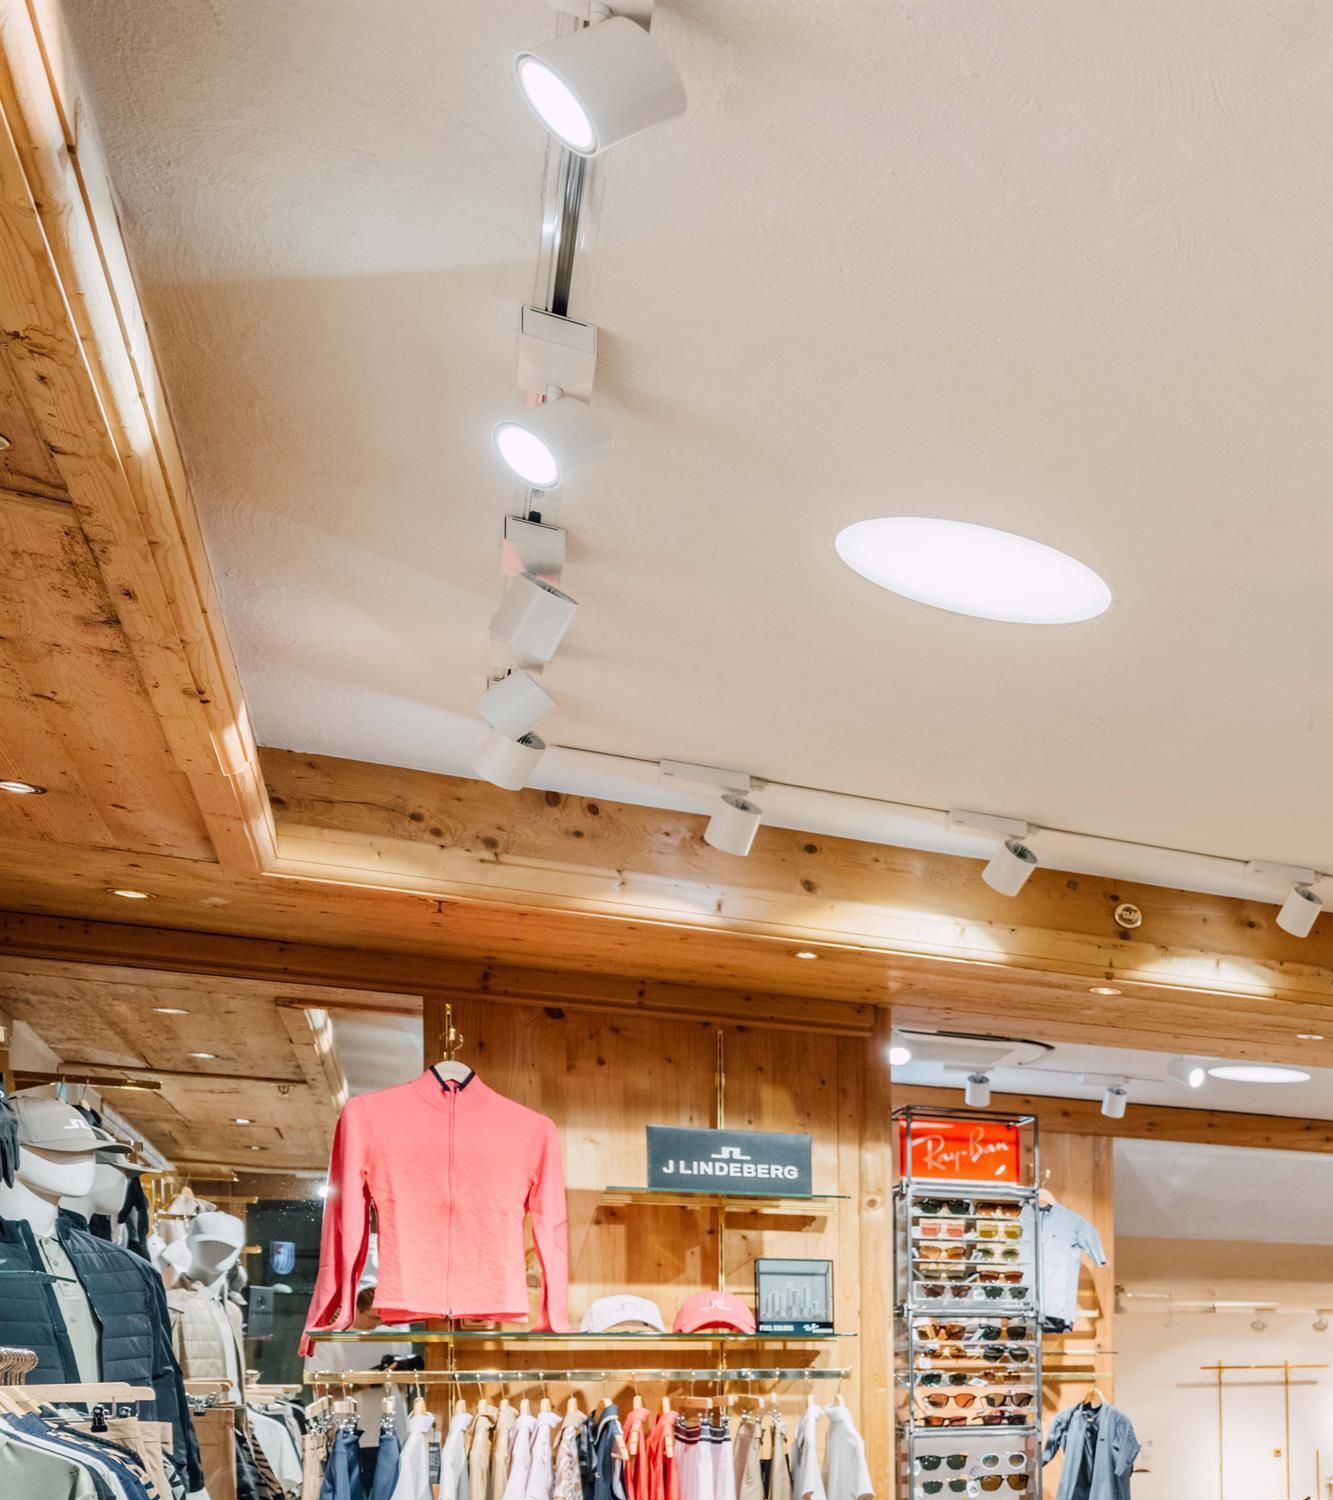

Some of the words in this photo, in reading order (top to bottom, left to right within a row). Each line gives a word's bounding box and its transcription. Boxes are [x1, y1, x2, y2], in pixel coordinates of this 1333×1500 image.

[911, 1127, 1009, 1173] Ray-Ban
[662, 1159, 674, 1174] J
[679, 1160, 799, 1179] LINDEBERG
